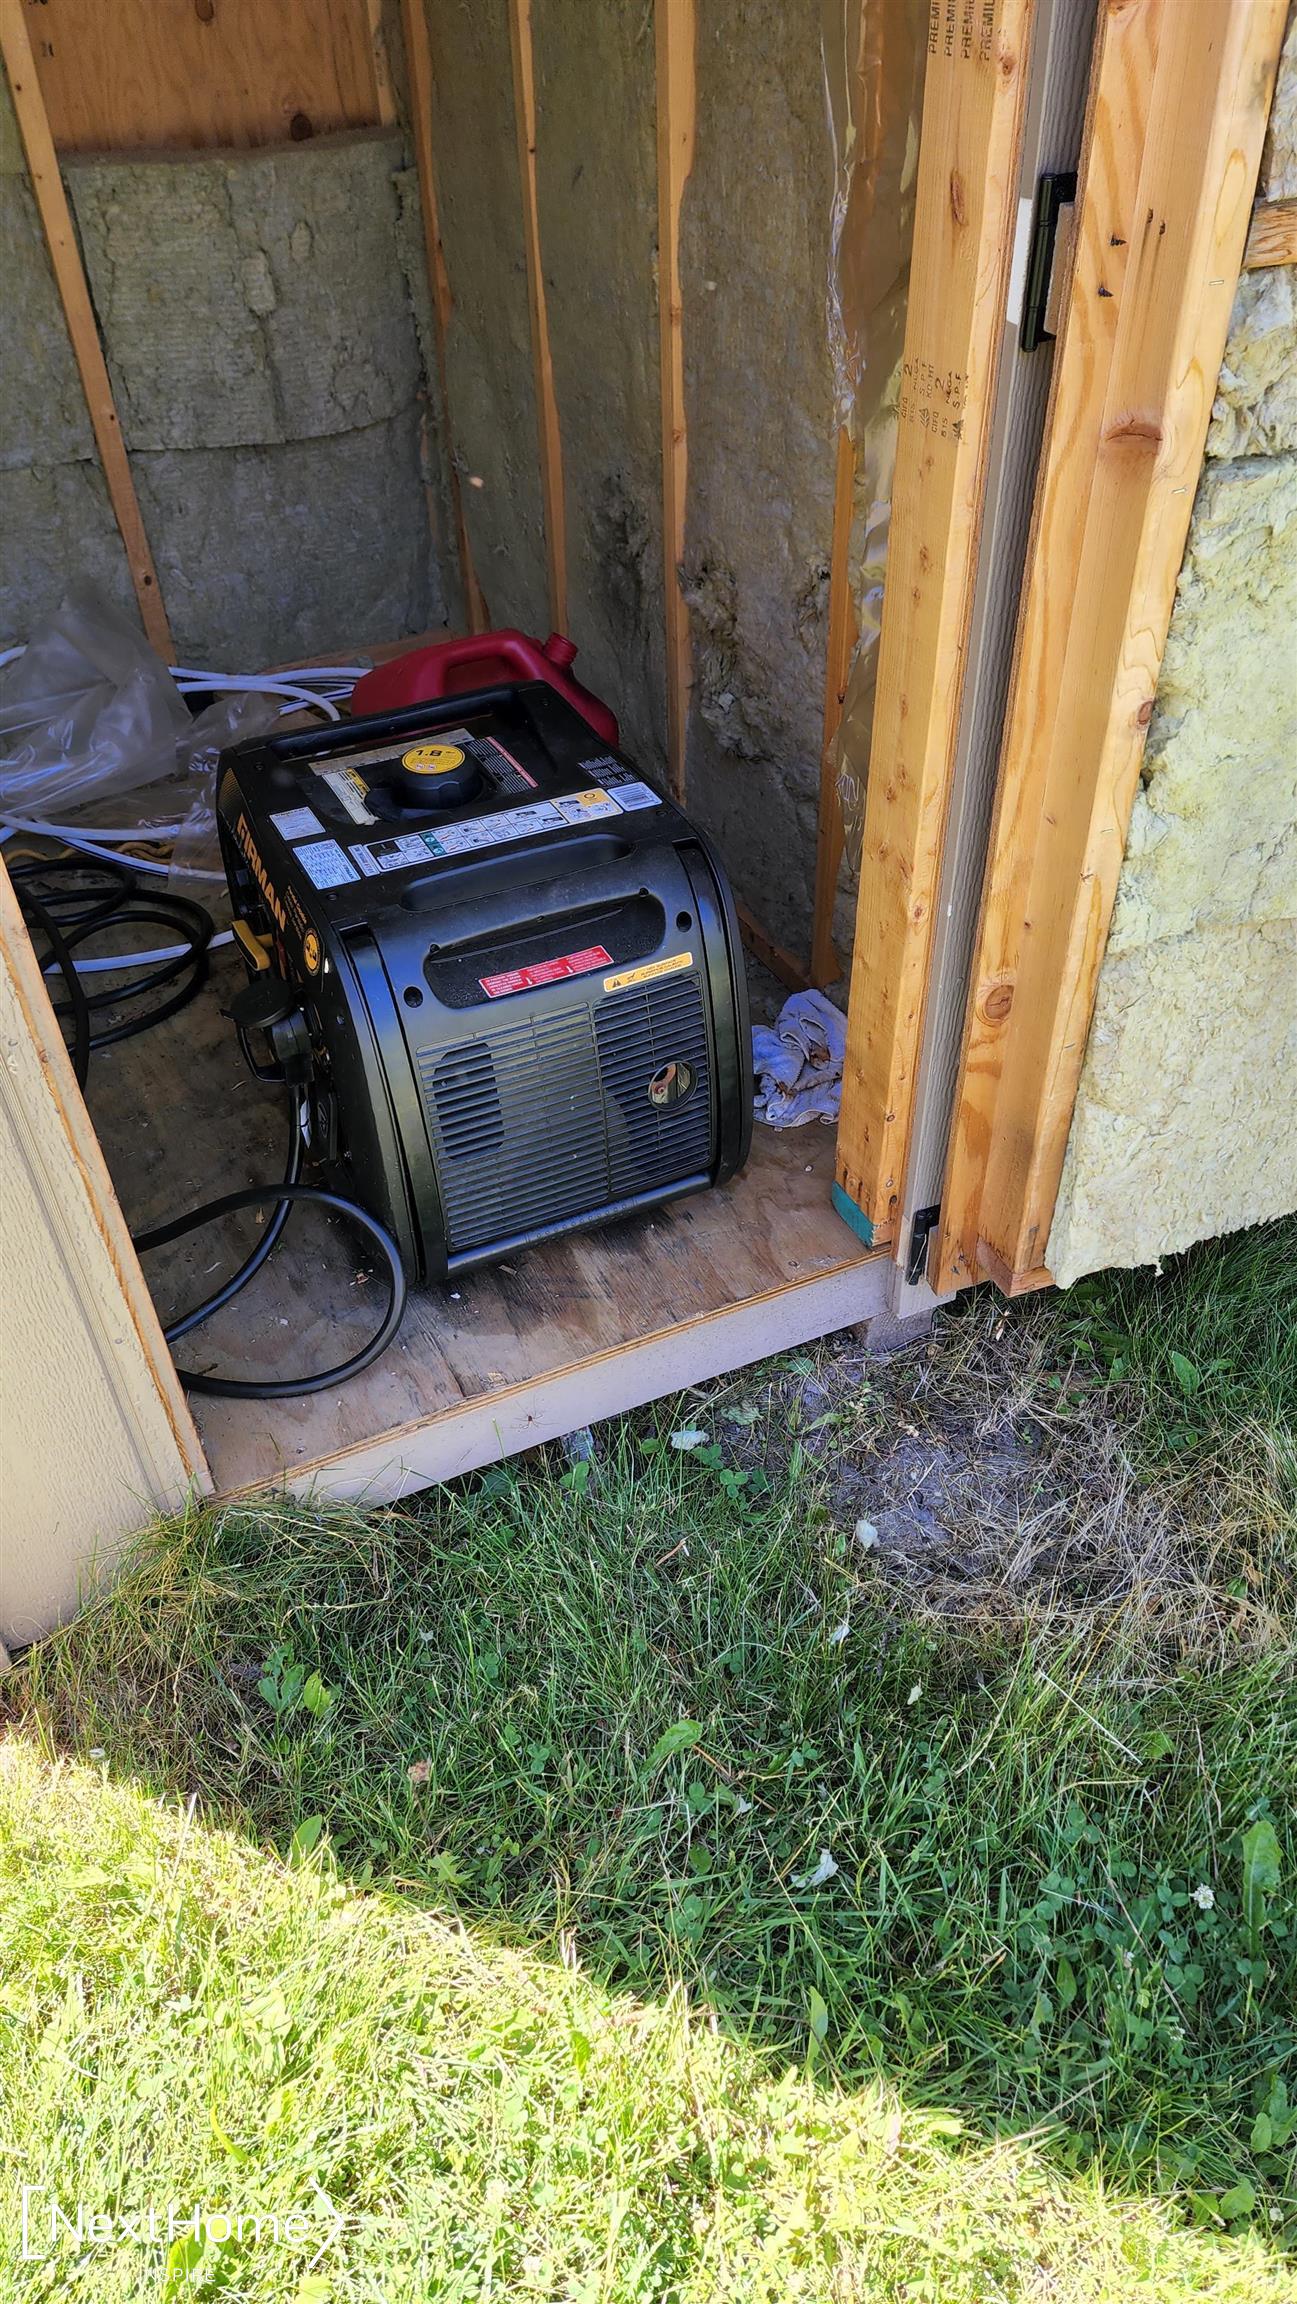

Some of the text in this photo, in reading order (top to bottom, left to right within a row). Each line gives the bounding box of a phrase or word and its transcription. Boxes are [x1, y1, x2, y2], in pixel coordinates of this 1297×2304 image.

[944, 0, 955, 56] PREMI
[904, 364, 912, 376] 2
[935, 377, 944, 390] 2
[416, 749, 443, 757] 1.8
[237, 812, 286, 932] FIRMAN
